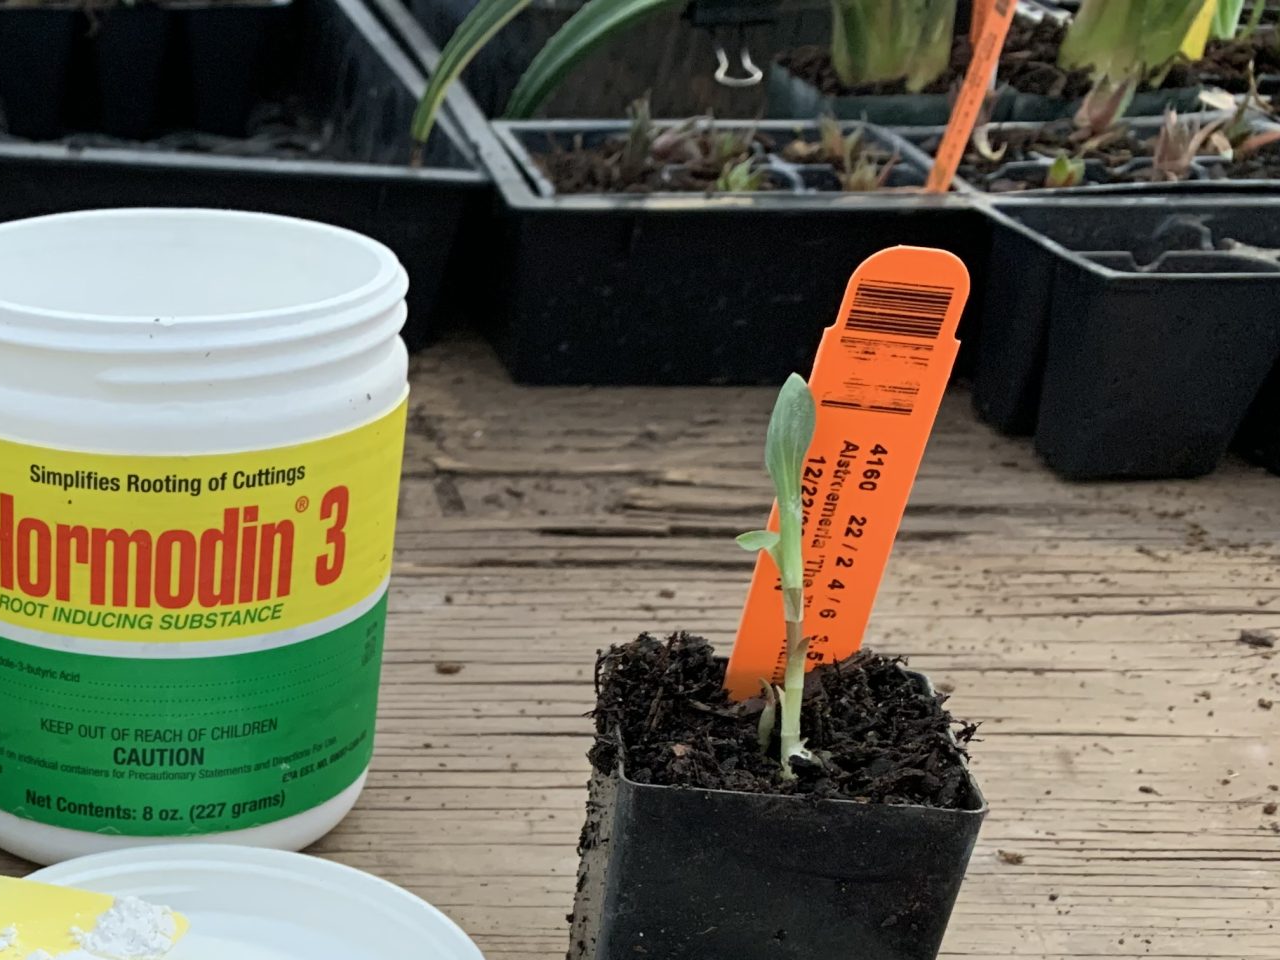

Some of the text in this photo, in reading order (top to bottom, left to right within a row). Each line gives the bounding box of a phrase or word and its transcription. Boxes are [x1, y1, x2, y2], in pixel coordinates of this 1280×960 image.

[29, 464, 307, 497] Simplifies Rooting of Cuttings
[859, 443, 889, 491] 4160
[315, 485, 350, 587] 3
[843, 514, 867, 538] 22
[51, 607, 154, 631] INDUCING
[158, 603, 285, 631] SUBSTANCE
[59, 669, 81, 683] Acid
[40, 717, 278, 743] KEEP OUT OF REACH OF CHILDREN
[6, 750, 17, 759] on
[18, 752, 59, 770] individual
[60, 762, 110, 778] containers
[112, 768, 126, 779] for
[128, 769, 195, 781] Precautionary
[198, 763, 252, 780] Statements
[254, 759, 270, 772] and
[272, 750, 311, 767] Directions
[113, 747, 205, 767] CAUTION
[25, 788, 286, 823] Net Contents: 8 oz. (227 grams)
